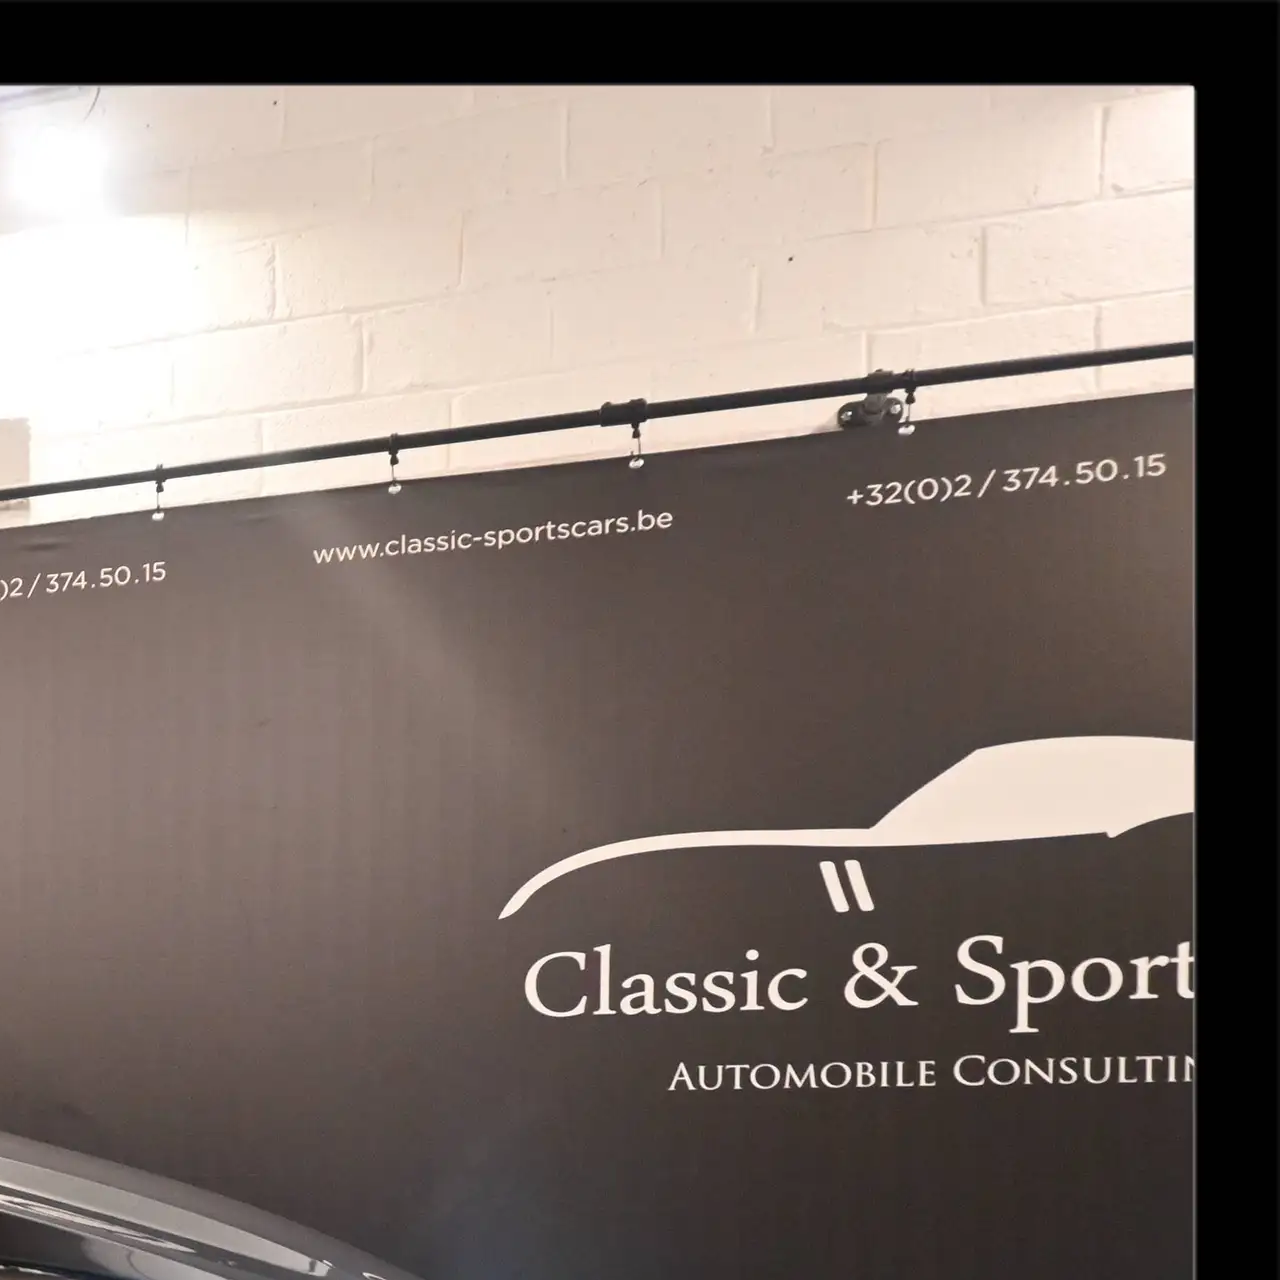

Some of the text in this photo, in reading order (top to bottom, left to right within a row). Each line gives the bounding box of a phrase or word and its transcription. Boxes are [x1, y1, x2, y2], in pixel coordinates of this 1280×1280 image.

[846, 475, 972, 506] +32(0)2
[1002, 453, 1167, 492] 374.50.15
[312, 509, 673, 565] www.classic-sportscars.be
[45, 561, 166, 594] 374.50.15
[524, 934, 1195, 1034] Classic & Sport
[667, 1060, 936, 1091] AUTOMOBILE
